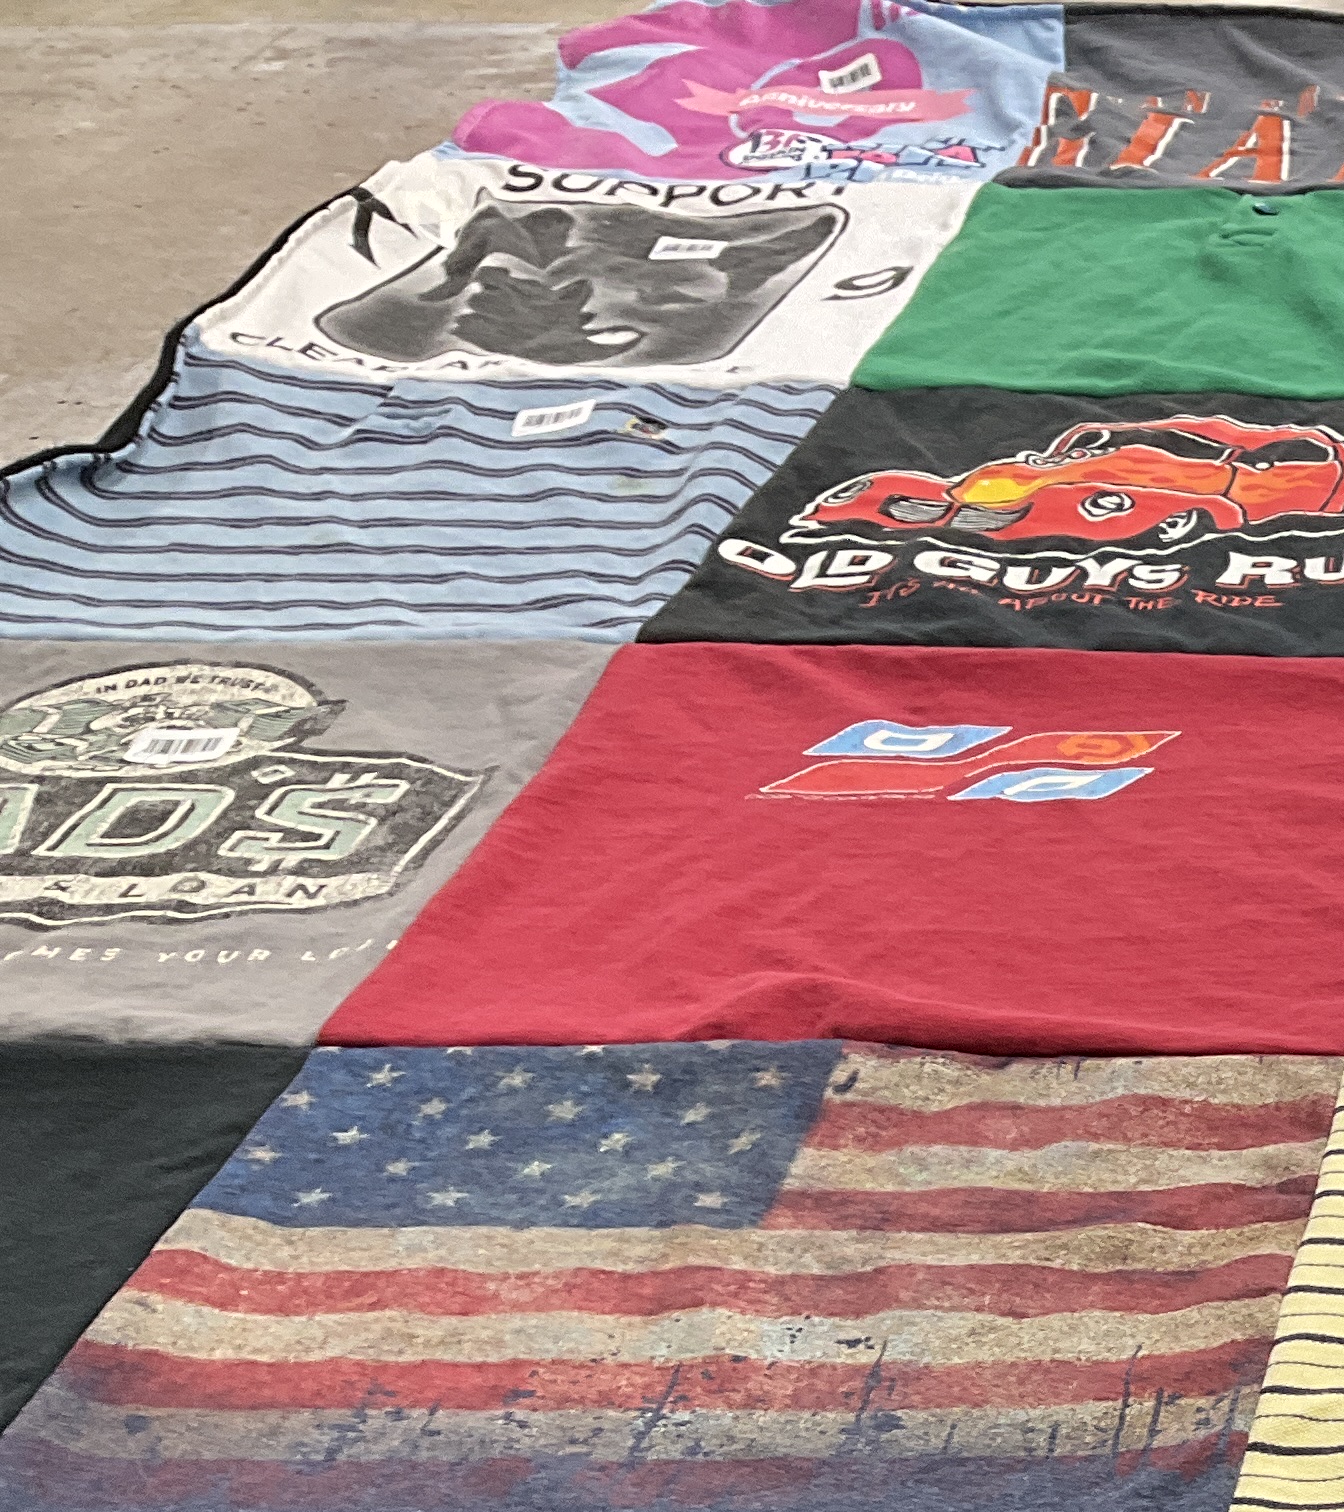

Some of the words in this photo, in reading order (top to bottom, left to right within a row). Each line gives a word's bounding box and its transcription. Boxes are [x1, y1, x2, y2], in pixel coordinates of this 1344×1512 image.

[718, 537, 897, 593] OLD
[913, 548, 1190, 595] GUYS
[1127, 597, 1175, 610] THE
[1192, 589, 1283, 607] RIDE
[125, 677, 167, 689] DAD
[117, 878, 328, 900] LOAN
[156, 948, 272, 964] YOUR
